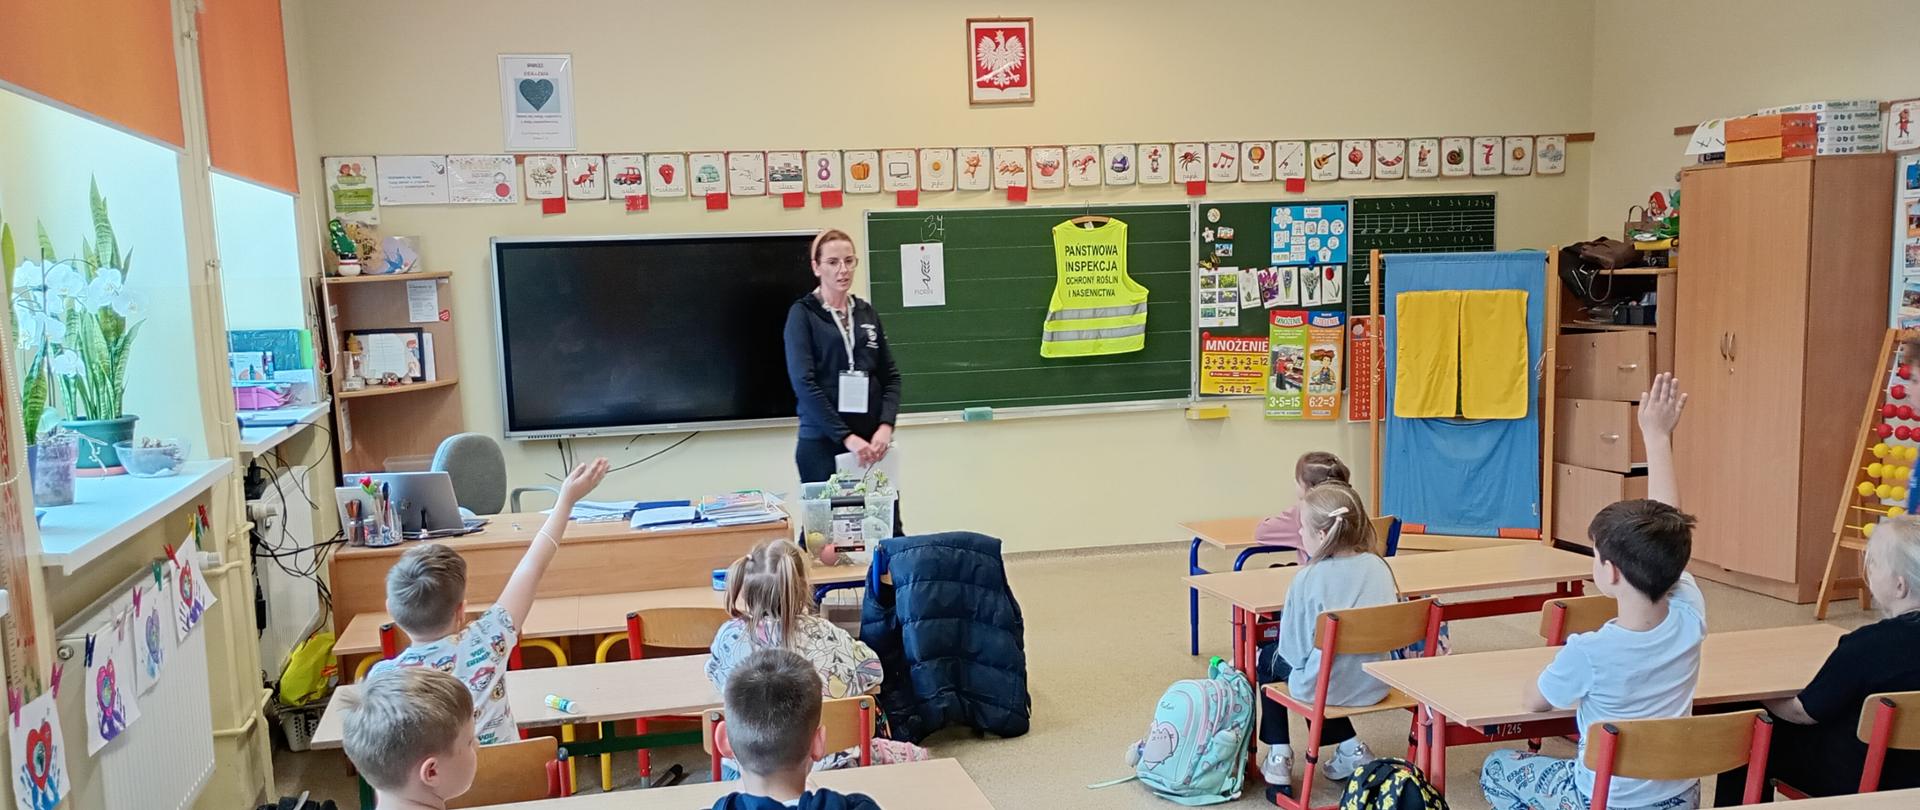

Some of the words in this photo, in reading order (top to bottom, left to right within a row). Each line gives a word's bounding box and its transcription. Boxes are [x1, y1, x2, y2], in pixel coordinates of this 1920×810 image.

[1064, 242, 1119, 256] PAŃSTWOWA
[1065, 260, 1118, 272] INSPEKCJA
[1065, 276, 1095, 285] OCHRONY
[1096, 275, 1119, 284] ROŚLIN
[1205, 338, 1269, 352] MNOŻENIE
